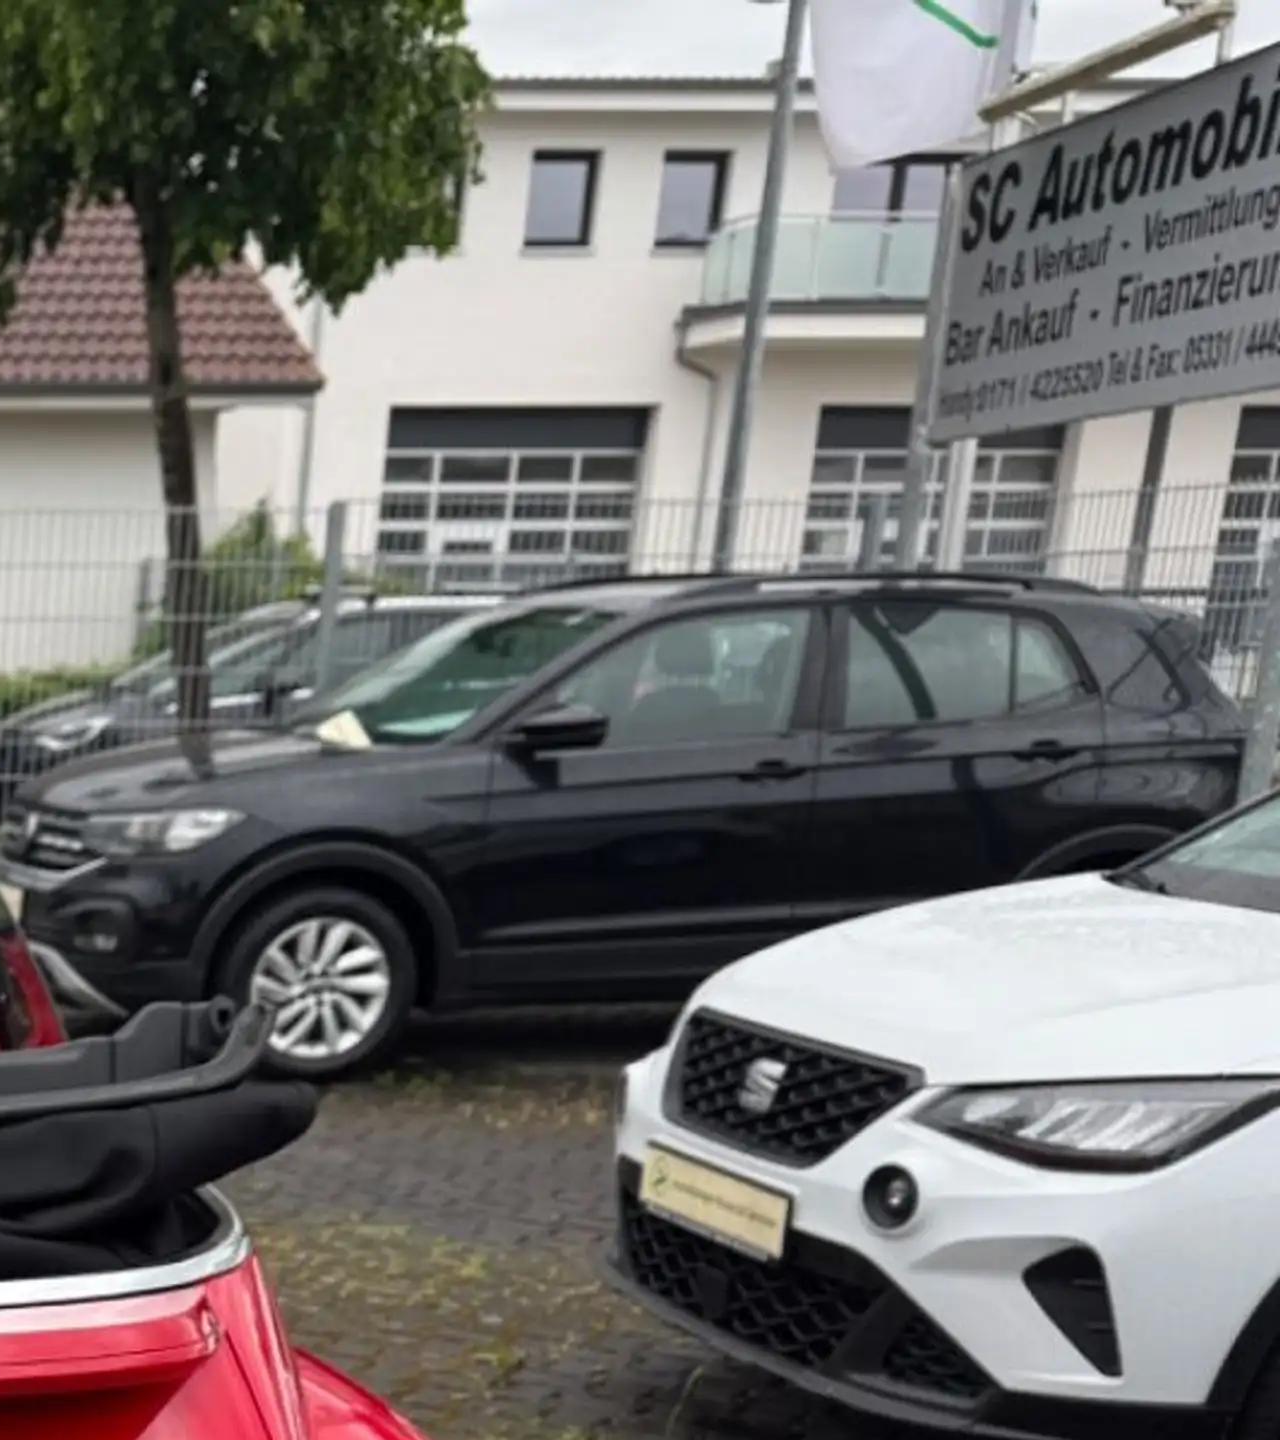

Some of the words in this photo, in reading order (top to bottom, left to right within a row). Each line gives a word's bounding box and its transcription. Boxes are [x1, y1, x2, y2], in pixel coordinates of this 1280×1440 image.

[961, 161, 1022, 254] SC
[1027, 65, 1280, 232] Automobi
[978, 259, 1007, 297] An
[1033, 224, 1114, 284] Verkauf
[1144, 185, 1280, 254] Vermittlung
[944, 320, 985, 368] Bar
[986, 287, 1080, 357] Ankauf
[1244, 316, 1280, 362] 444
